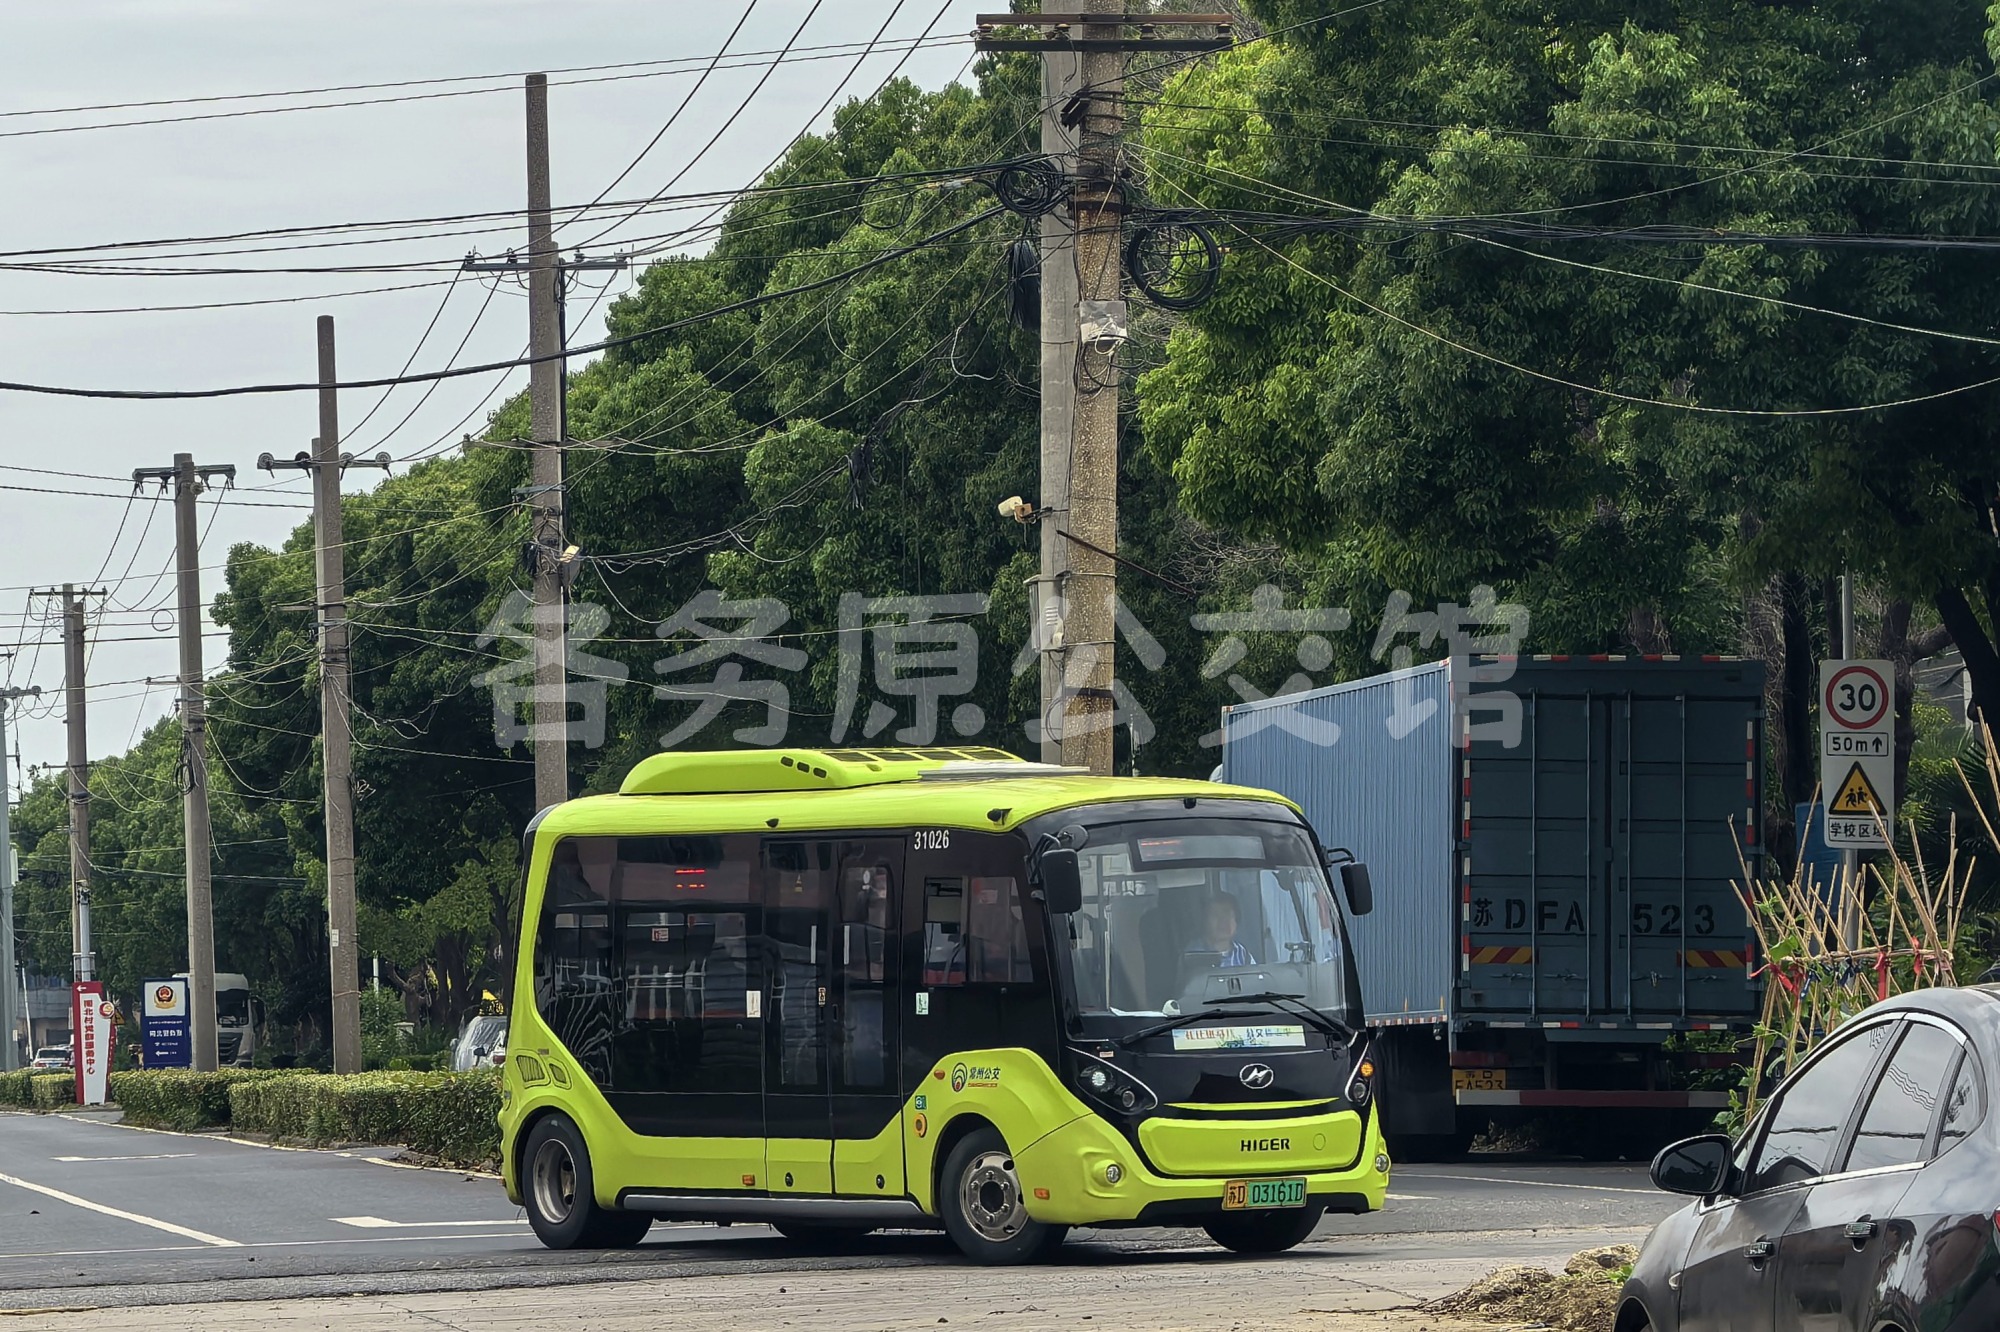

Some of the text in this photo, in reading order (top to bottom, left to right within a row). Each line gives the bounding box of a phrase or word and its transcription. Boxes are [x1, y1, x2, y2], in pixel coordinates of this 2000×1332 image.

[1839, 684, 1876, 711] 30
[1832, 737, 1868, 752] 50m
[914, 829, 950, 850] 31026
[1240, 1138, 1290, 1152] HIGER
